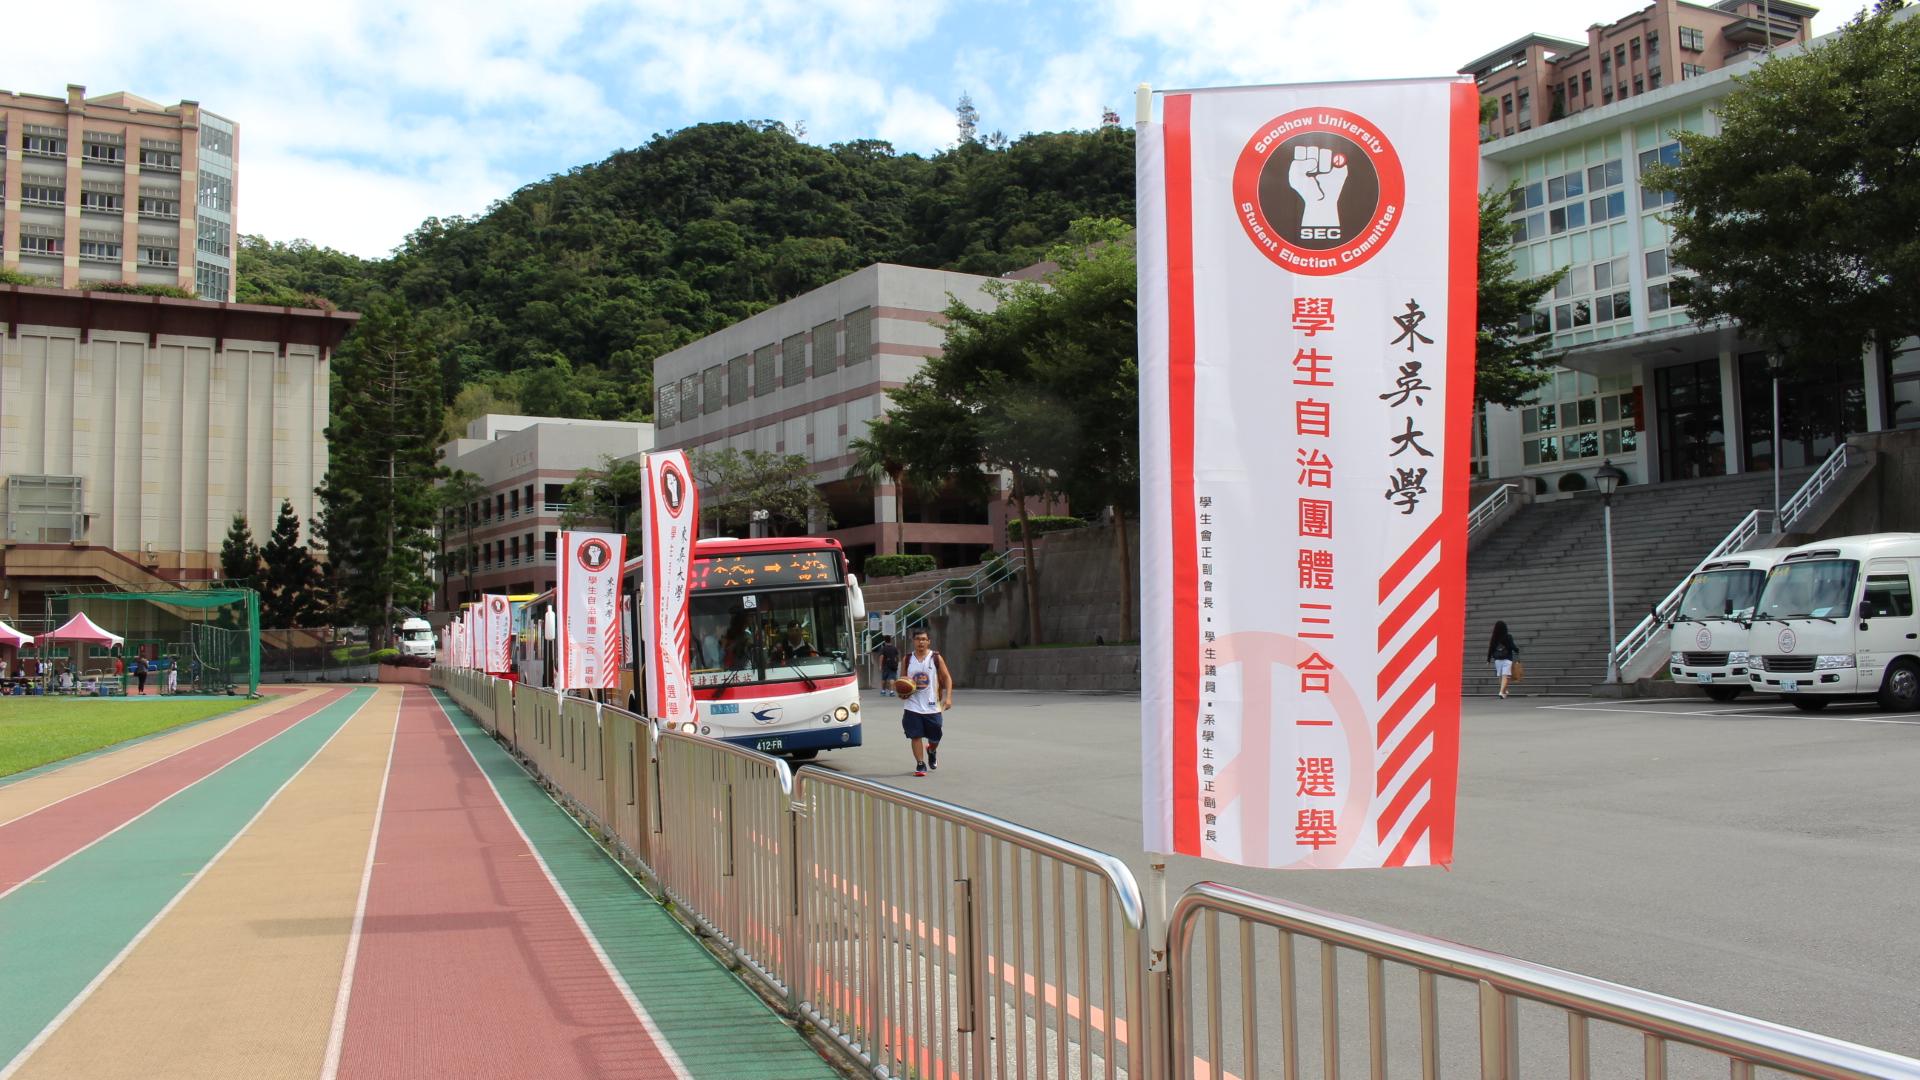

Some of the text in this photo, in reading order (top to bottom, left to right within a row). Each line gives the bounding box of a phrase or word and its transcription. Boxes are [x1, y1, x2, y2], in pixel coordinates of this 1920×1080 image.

[1254, 114, 1384, 155] Soochow University
[1242, 202, 1396, 268] Student Election Committee
[1300, 228, 1341, 240] SEC
[1378, 298, 1435, 515] 東吳大學
[1292, 297, 1338, 850] 學生自治團體三合一選舉
